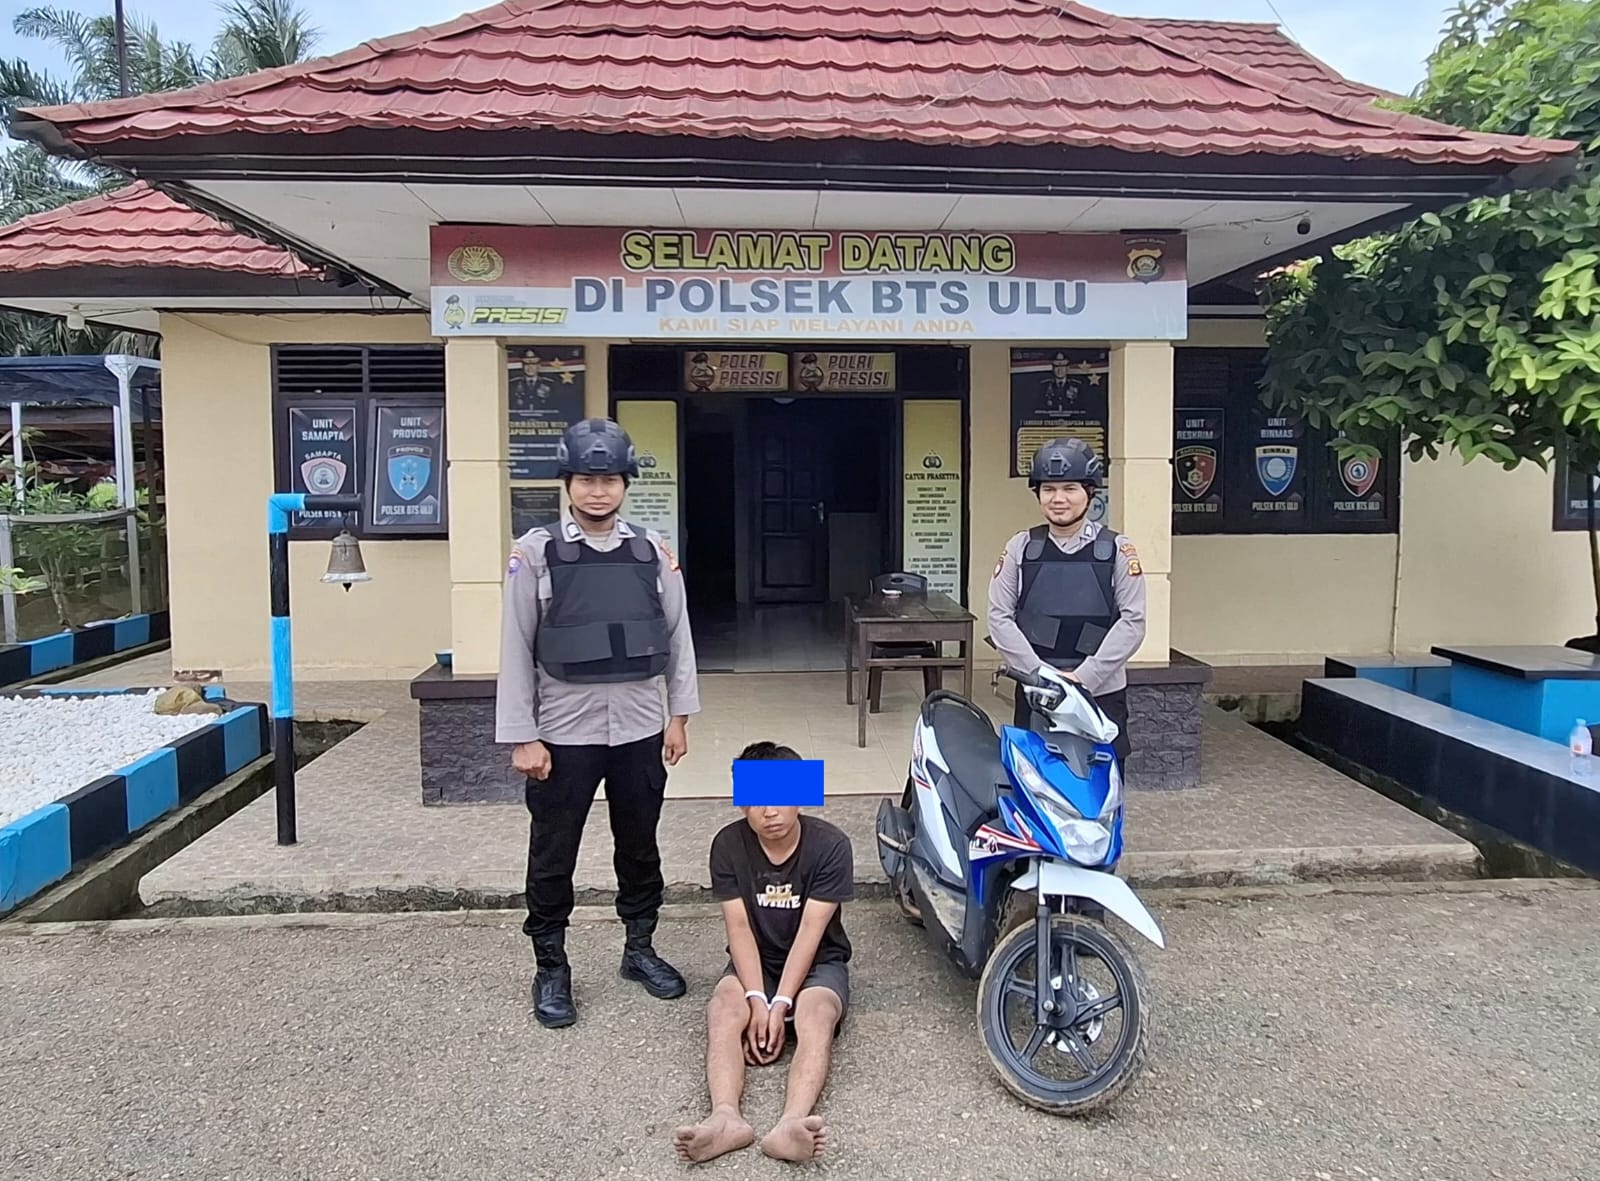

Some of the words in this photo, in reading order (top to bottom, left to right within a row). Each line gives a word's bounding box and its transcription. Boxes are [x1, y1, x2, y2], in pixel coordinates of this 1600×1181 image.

[622, 231, 830, 271] SELAMAT
[841, 233, 1015, 274] DATANG
[574, 278, 624, 313] DI
[645, 278, 853, 314] POLSEK
[871, 280, 971, 315] BTS
[987, 281, 1088, 315] ULU
[471, 306, 568, 325] PRESISI
[659, 318, 718, 332] KAMI
[727, 318, 780, 332] SIAP
[788, 318, 904, 333] MELAYANI
[912, 319, 975, 334] ANDA
[719, 354, 766, 369] POLRI
[828, 354, 873, 370] POLRI
[719, 370, 783, 386] PRESISI
[827, 371, 889, 386] PRESISI
[312, 418, 333, 429] UNIT
[401, 416, 422, 427] UNIT
[1185, 418, 1205, 428] UNIT
[1267, 417, 1287, 427] UNIT
[302, 431, 344, 441] SAMAPTA
[393, 429, 428, 439] PROVOS
[1176, 430, 1214, 440] RESKRIM
[1260, 429, 1294, 439] BINMAS
[304, 449, 342, 460] SAMAPTA
[641, 471, 672, 480] BRATA
[904, 472, 926, 481] CATUR
[381, 505, 405, 515] POLSEK
[765, 883, 793, 895] OFF
[756, 892, 801, 909] WHITE
